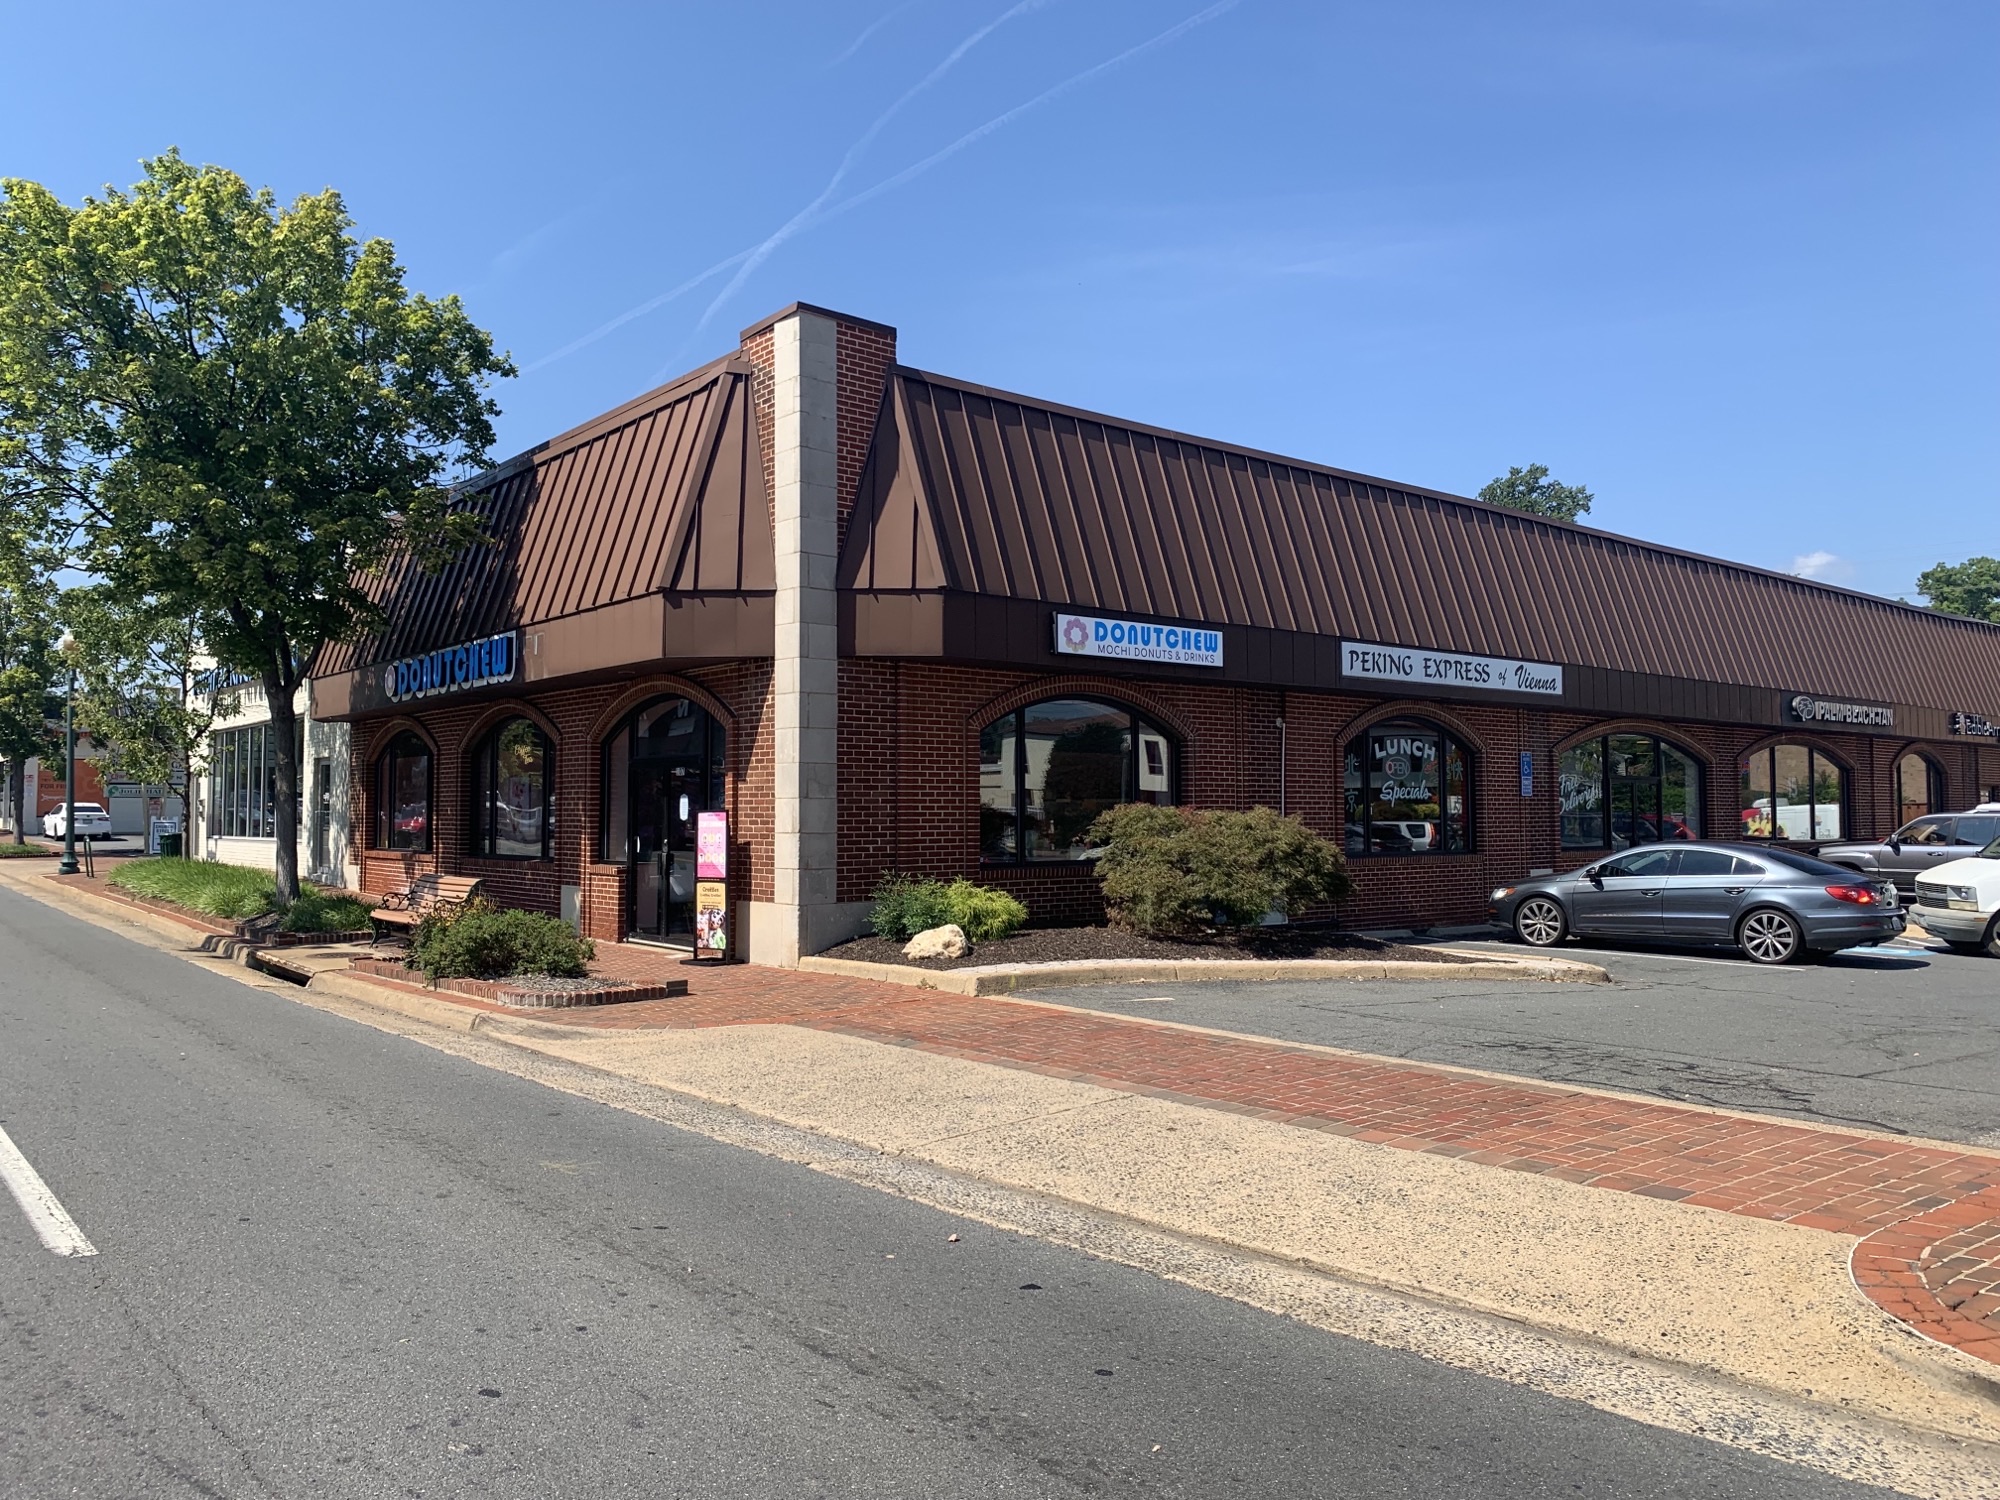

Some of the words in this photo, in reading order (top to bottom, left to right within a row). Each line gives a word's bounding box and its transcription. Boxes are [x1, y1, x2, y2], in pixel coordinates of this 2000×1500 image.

[1094, 621, 1218, 653] DONUTCHEW
[397, 635, 508, 695] DONUTCHEW
[1097, 643, 1131, 657] MOCHI
[1134, 647, 1173, 661] DONUTS
[1175, 650, 1182, 661] &
[1183, 651, 1216, 664] DRINKS
[1348, 650, 1413, 677] PEKING
[1423, 657, 1491, 683] EXPRESS
[1498, 667, 1508, 686] of
[1514, 664, 1558, 692] Vienna
[1817, 701, 1845, 722] PALM
[1846, 704, 1876, 726] BEACH
[1876, 707, 1893, 727] TAN
[1374, 738, 1436, 761] LUNCH
[1385, 761, 1409, 775] OPEN
[1380, 779, 1432, 808] Specials
